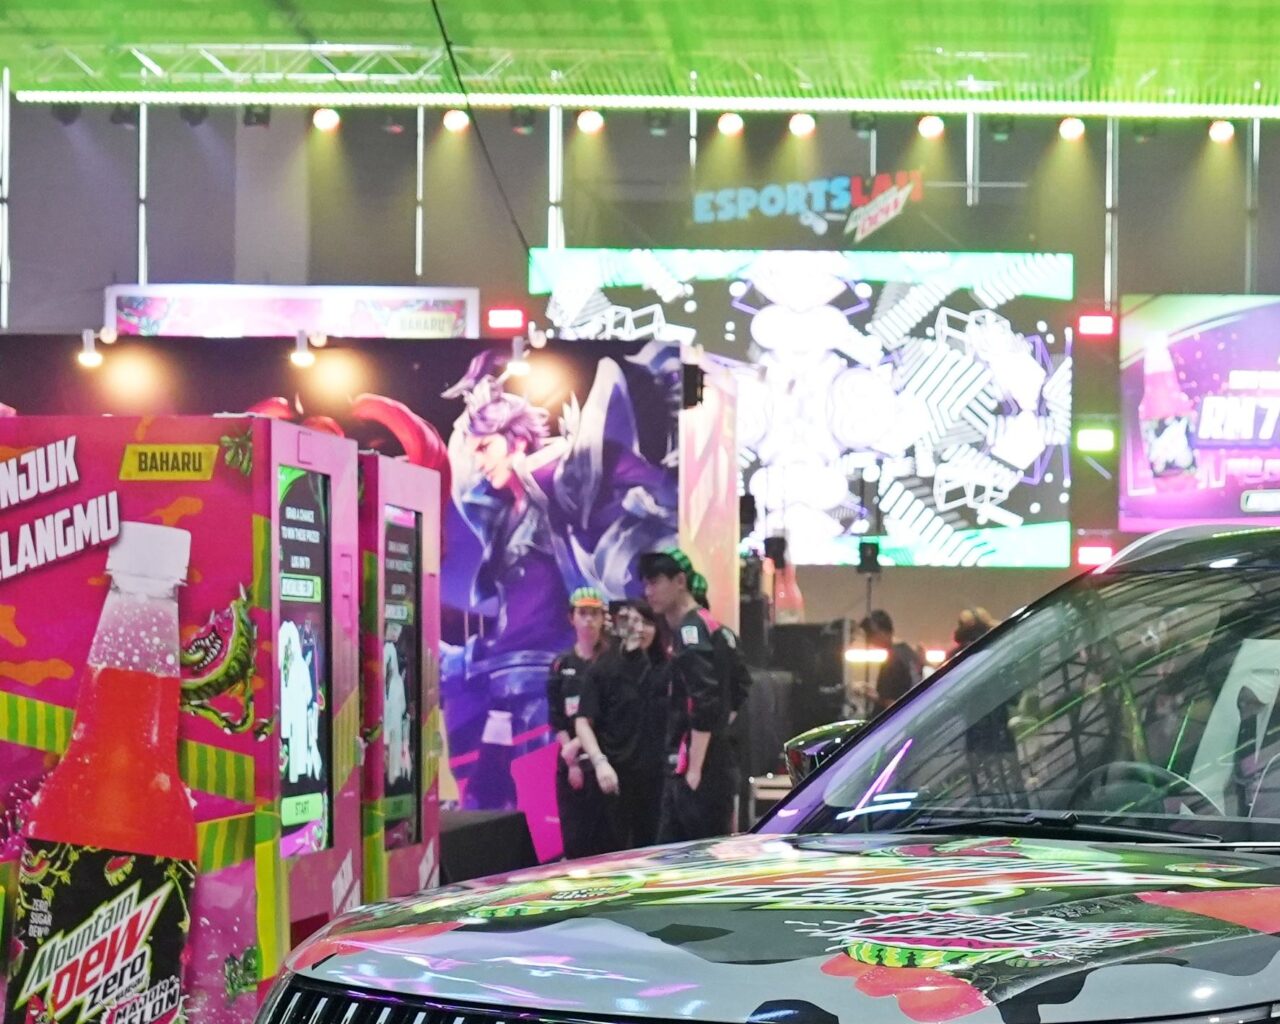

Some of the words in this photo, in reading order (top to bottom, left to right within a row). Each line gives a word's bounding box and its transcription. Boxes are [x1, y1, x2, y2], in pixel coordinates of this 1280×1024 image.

[138, 452, 203, 472] BAHARU
[295, 800, 310, 816] START
[26, 892, 135, 993] Mountain
